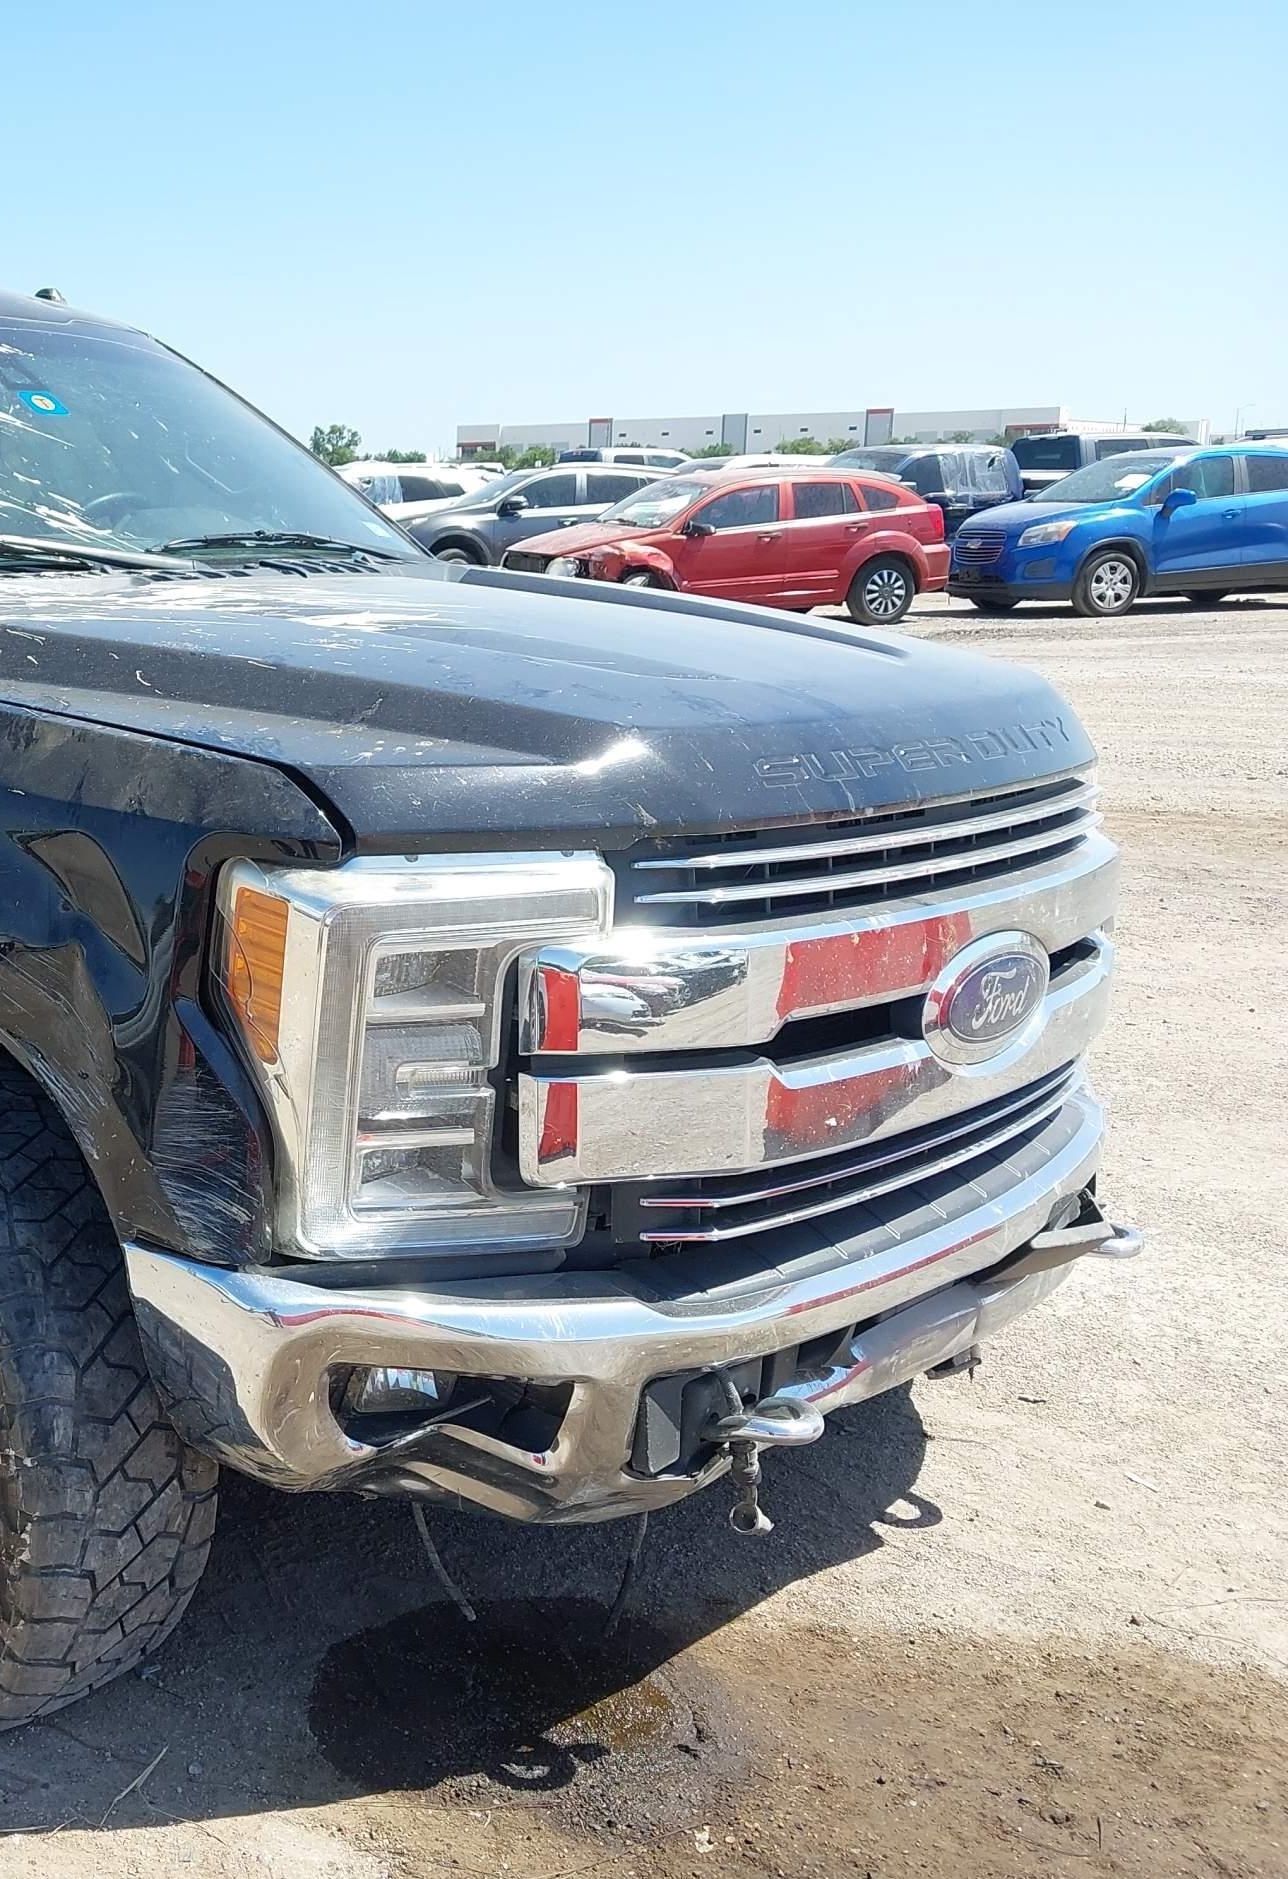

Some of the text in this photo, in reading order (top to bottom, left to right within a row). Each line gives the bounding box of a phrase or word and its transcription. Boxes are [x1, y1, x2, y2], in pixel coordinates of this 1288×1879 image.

[752, 716, 1070, 789] SUPER DUTY
[971, 968, 1031, 1030] Ford
